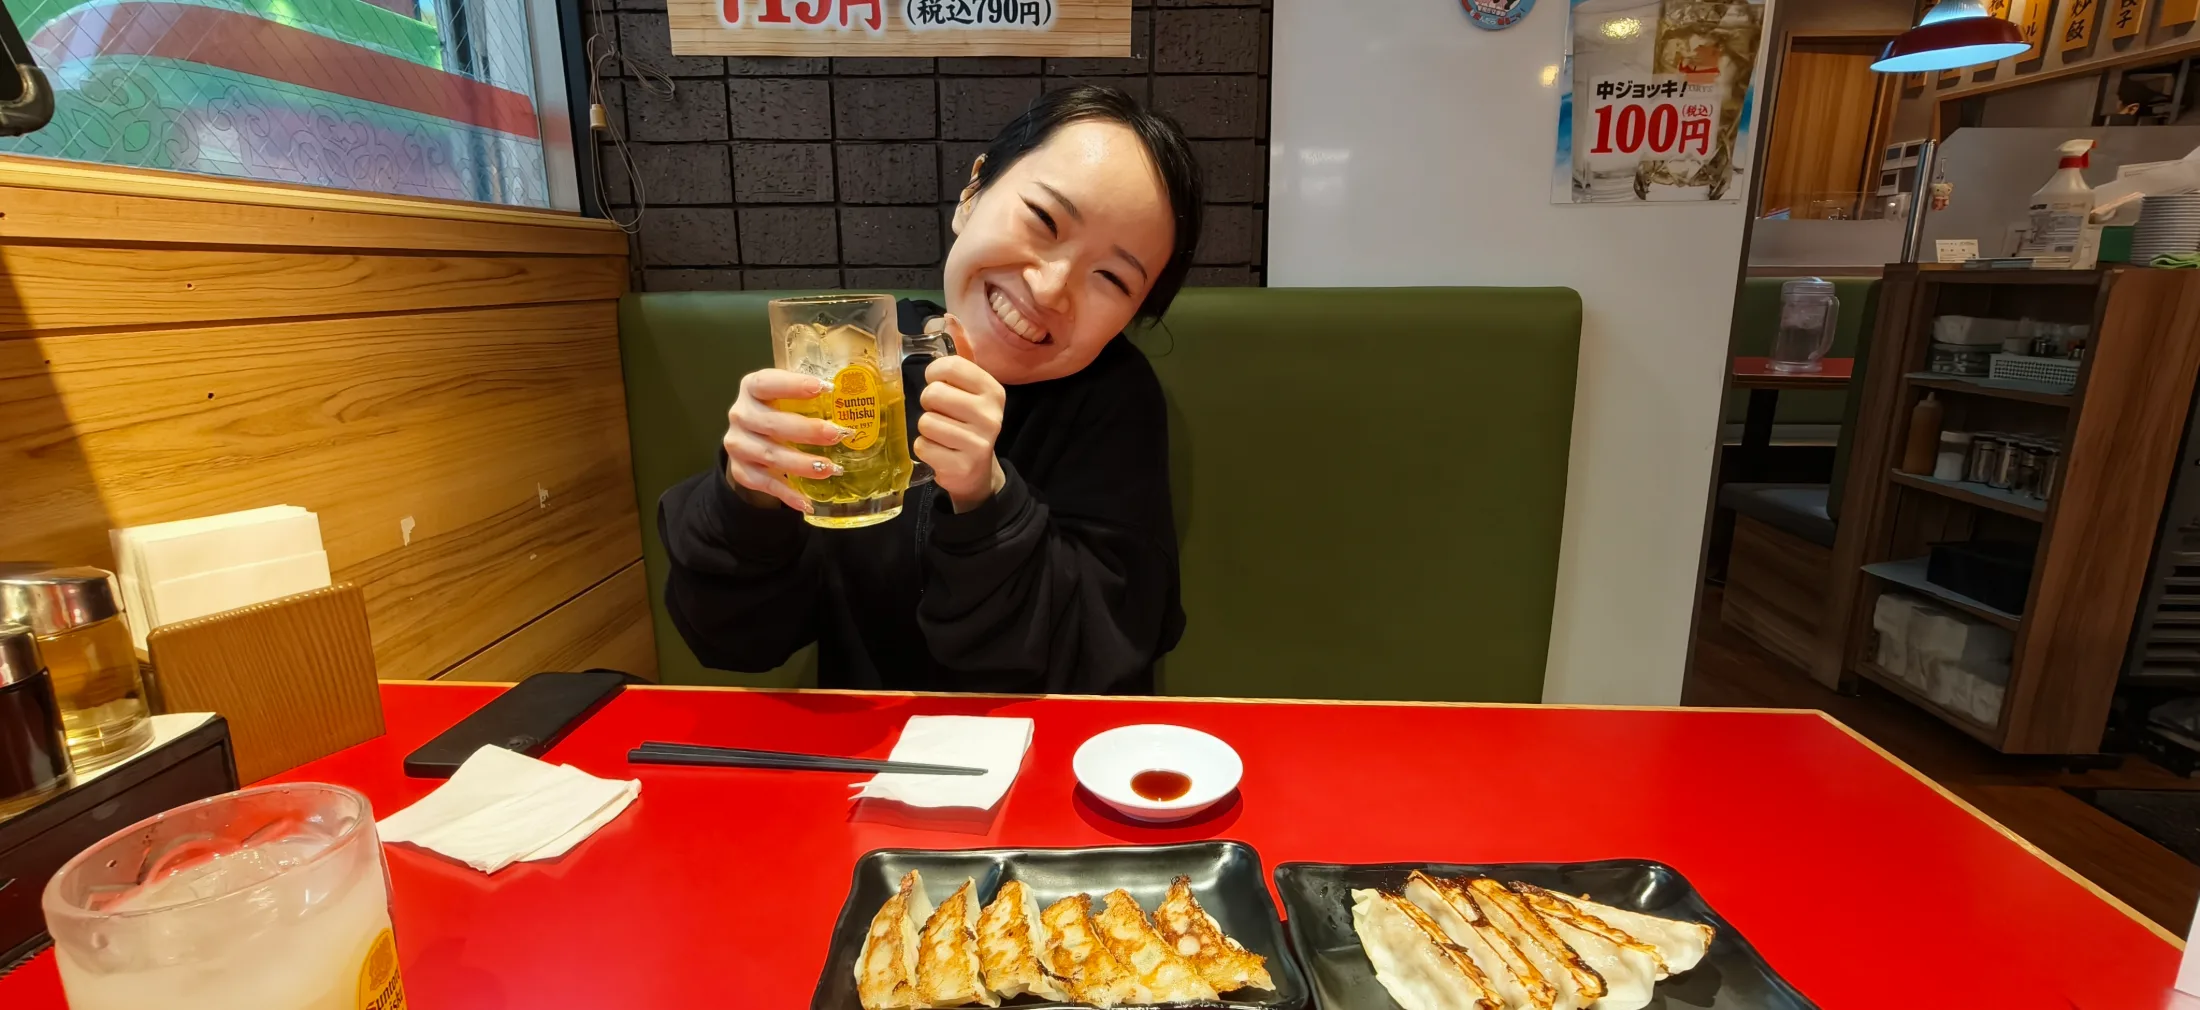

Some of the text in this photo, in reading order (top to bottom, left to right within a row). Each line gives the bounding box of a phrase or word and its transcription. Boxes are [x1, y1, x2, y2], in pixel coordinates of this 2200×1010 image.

[1597, 80, 1688, 99] 中ジョッキ!
[1590, 103, 1711, 155] 100円
[835, 396, 875, 408] Suntory
[837, 407, 875, 421] Whisky
